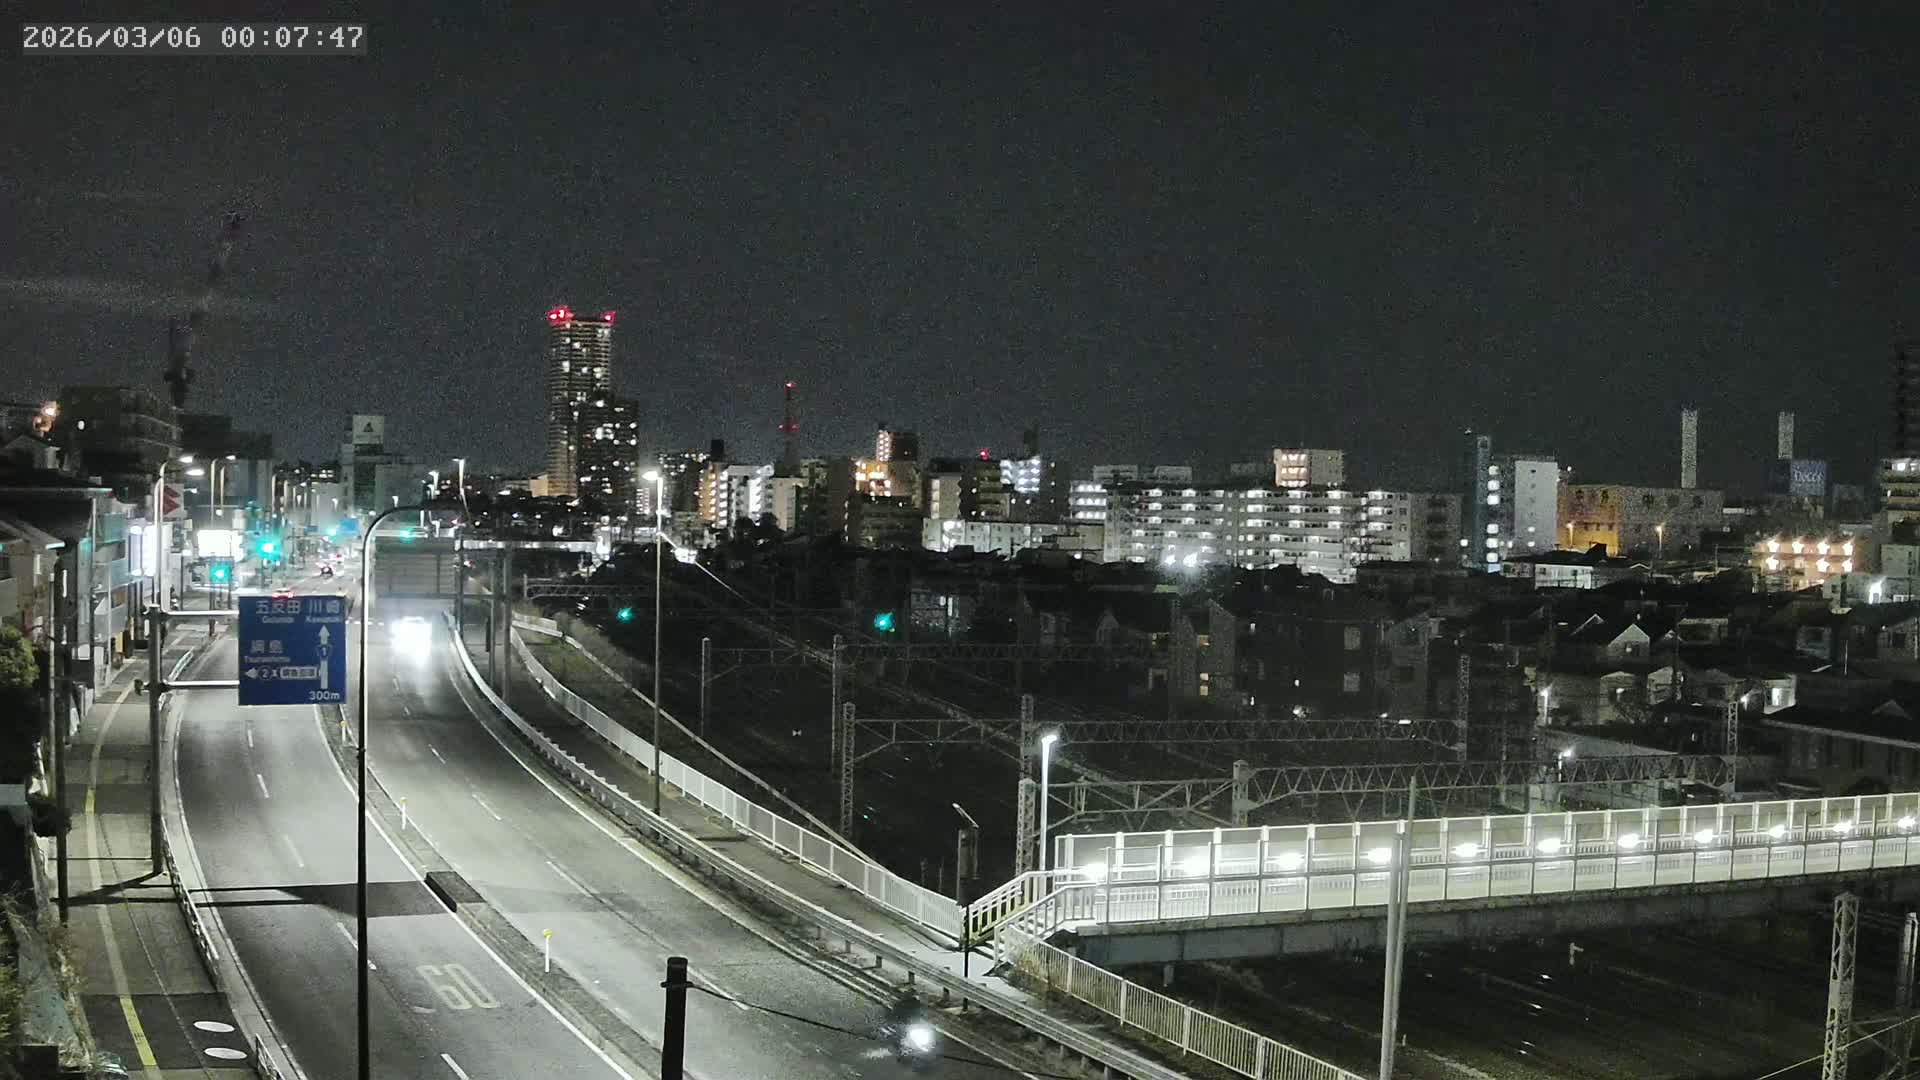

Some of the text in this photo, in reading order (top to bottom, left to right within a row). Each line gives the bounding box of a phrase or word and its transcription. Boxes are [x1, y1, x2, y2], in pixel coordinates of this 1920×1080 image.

[256, 600, 301, 614] 五反田
[308, 690, 341, 701] 300m
[415, 963, 499, 1010] 60
